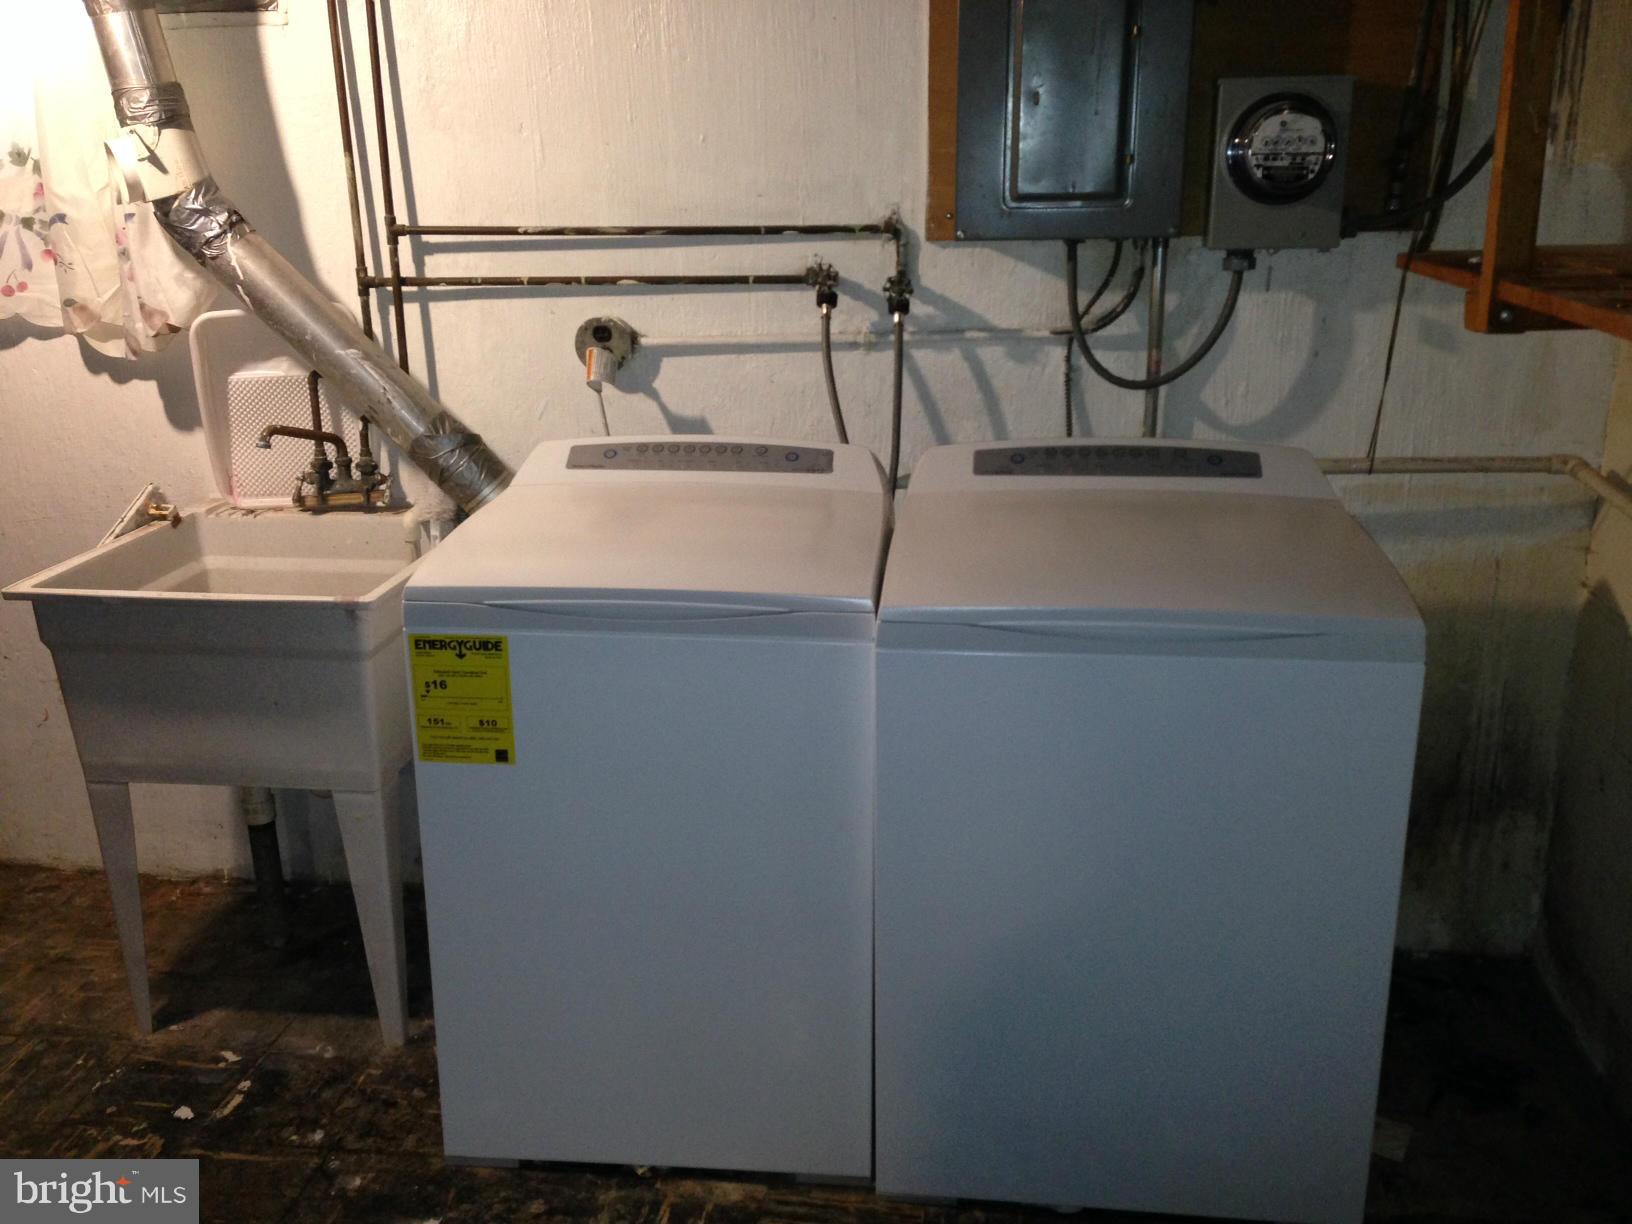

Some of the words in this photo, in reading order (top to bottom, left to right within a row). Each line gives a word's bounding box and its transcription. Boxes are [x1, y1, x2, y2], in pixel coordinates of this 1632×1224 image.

[415, 639, 503, 653] ENERGYGUIDE
[424, 680, 447, 690] $16
[427, 718, 445, 726] 151
[479, 719, 497, 727] $10
